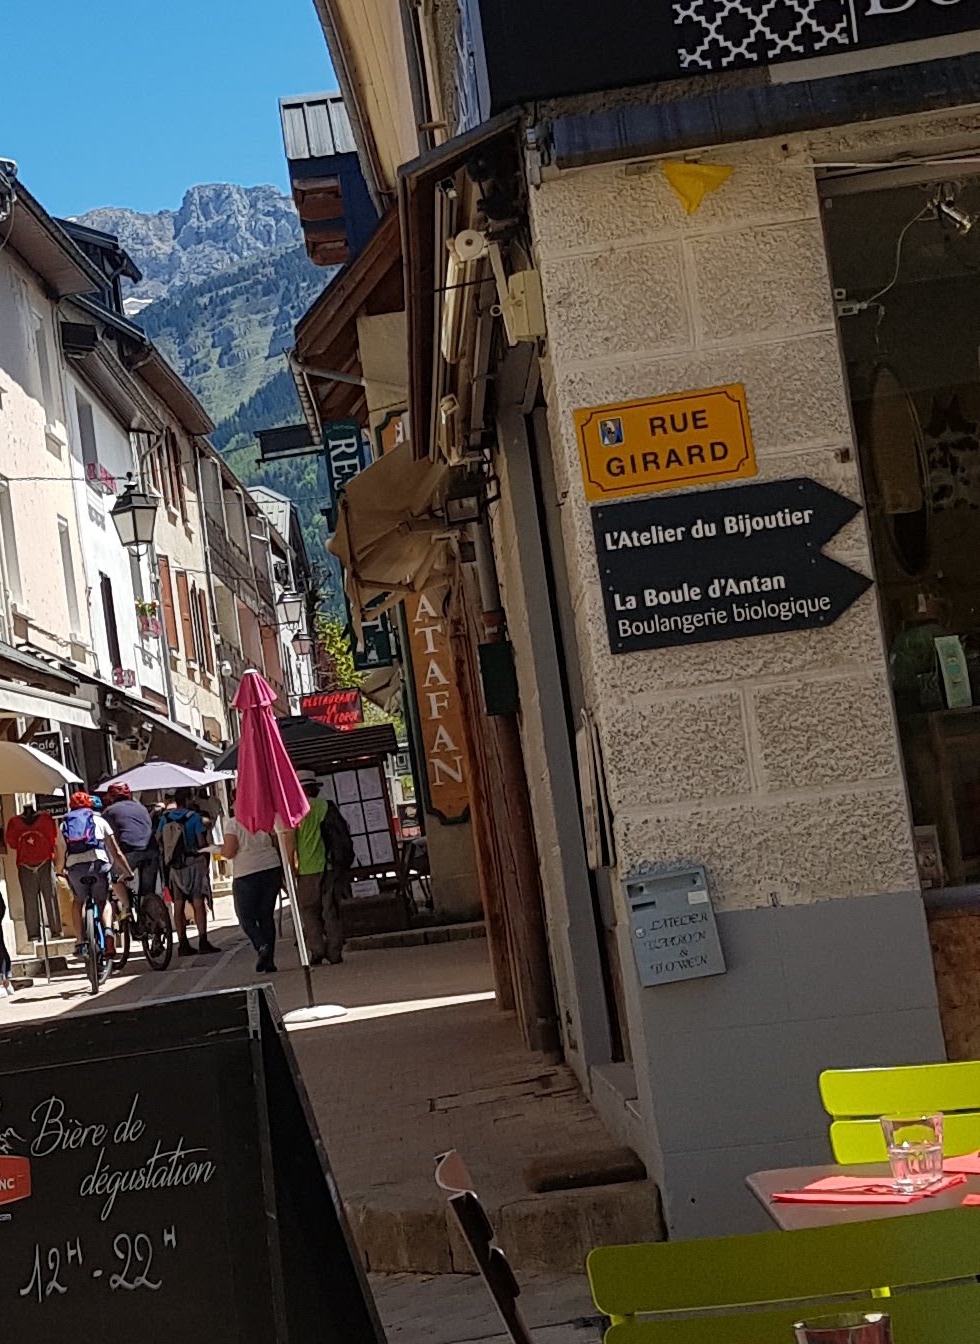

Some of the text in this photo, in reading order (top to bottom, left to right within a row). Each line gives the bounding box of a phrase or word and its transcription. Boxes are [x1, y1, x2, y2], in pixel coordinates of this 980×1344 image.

[649, 409, 709, 437] RUE
[606, 441, 729, 477] GIRARD
[605, 508, 813, 551] L'Atelier du Bijoutier
[613, 575, 786, 610] La Boule d'Antan
[618, 594, 832, 638] Boulangerie biologique
[30, 1093, 146, 1157] Bière de
[80, 1137, 216, 1221] dégustation
